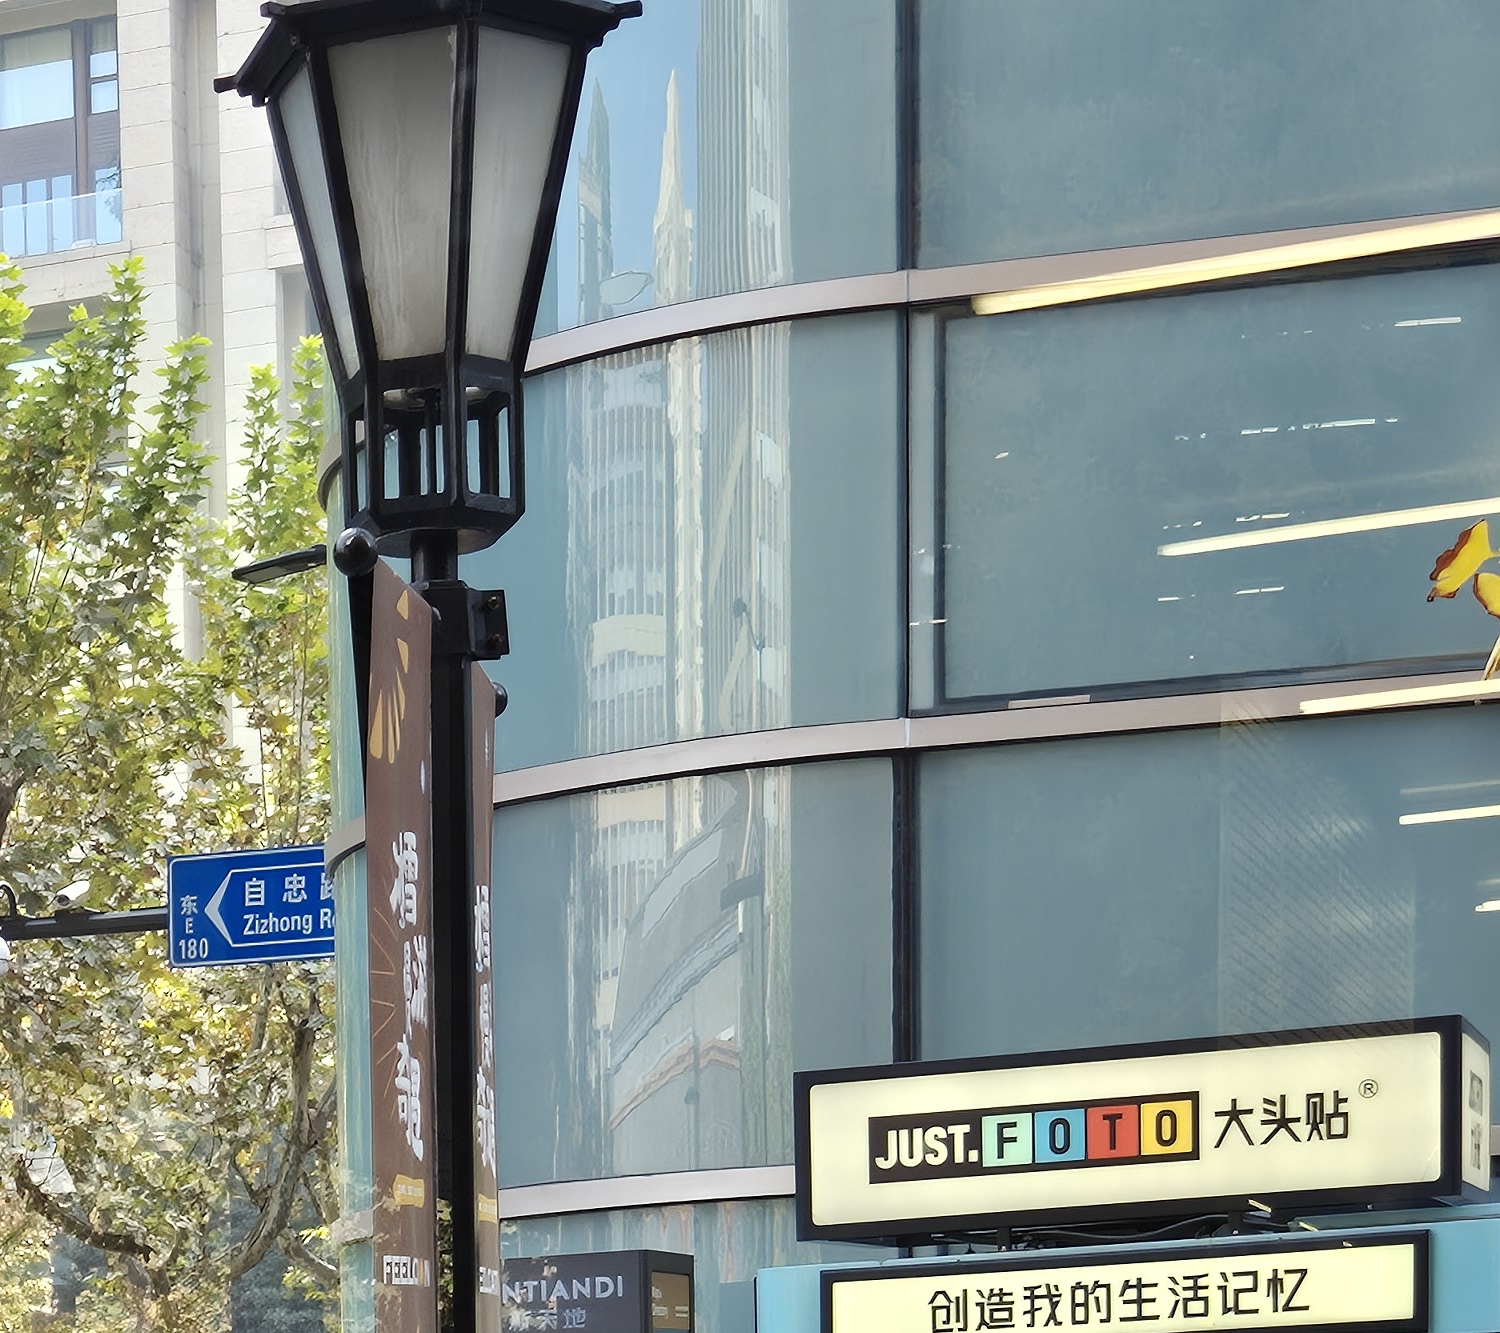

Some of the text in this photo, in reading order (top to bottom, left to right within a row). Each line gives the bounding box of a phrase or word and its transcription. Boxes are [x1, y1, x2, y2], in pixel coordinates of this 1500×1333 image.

[180, 895, 198, 915] 东
[185, 917, 194, 934] E
[243, 912, 313, 936] Zizhong
[178, 937, 209, 960] 180
[1213, 1089, 1350, 1149] 大头贴
[501, 1274, 624, 1304] NTIANDI
[928, 1268, 1311, 1333] 创造我的生活记忆
